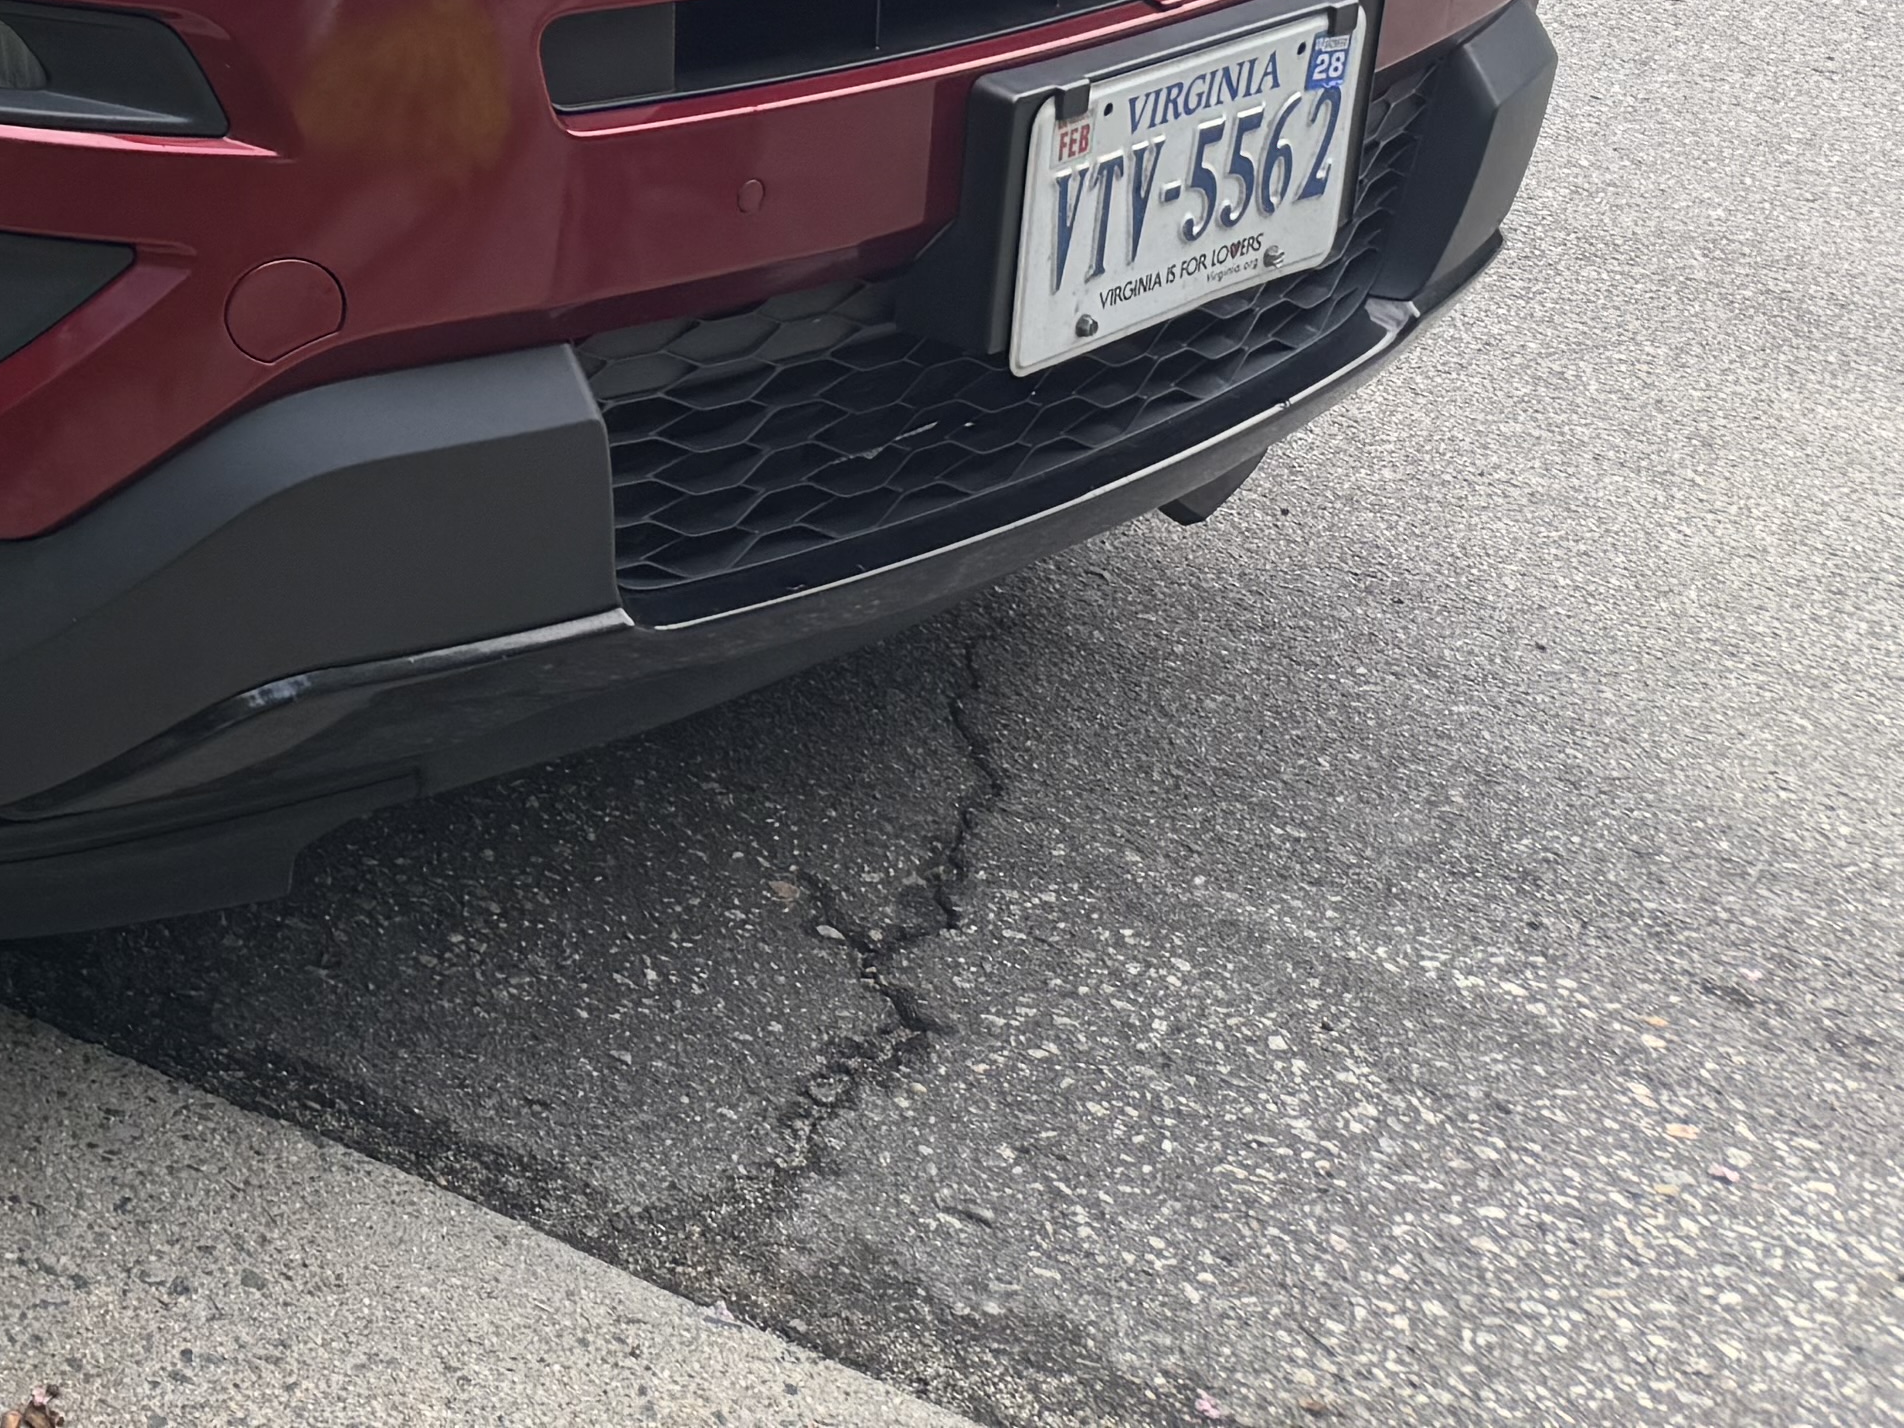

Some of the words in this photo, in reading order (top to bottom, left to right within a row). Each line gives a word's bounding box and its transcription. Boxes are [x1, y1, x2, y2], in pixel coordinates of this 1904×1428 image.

[1128, 49, 1281, 134] VIRGINIA
[1312, 52, 1345, 81] 28
[1058, 122, 1090, 162] FEB
[1052, 86, 1342, 294] VTV-5562
[1099, 268, 1163, 309] VIRGINIA
[1165, 262, 1177, 285] IS
[1180, 252, 1209, 279] FOR
